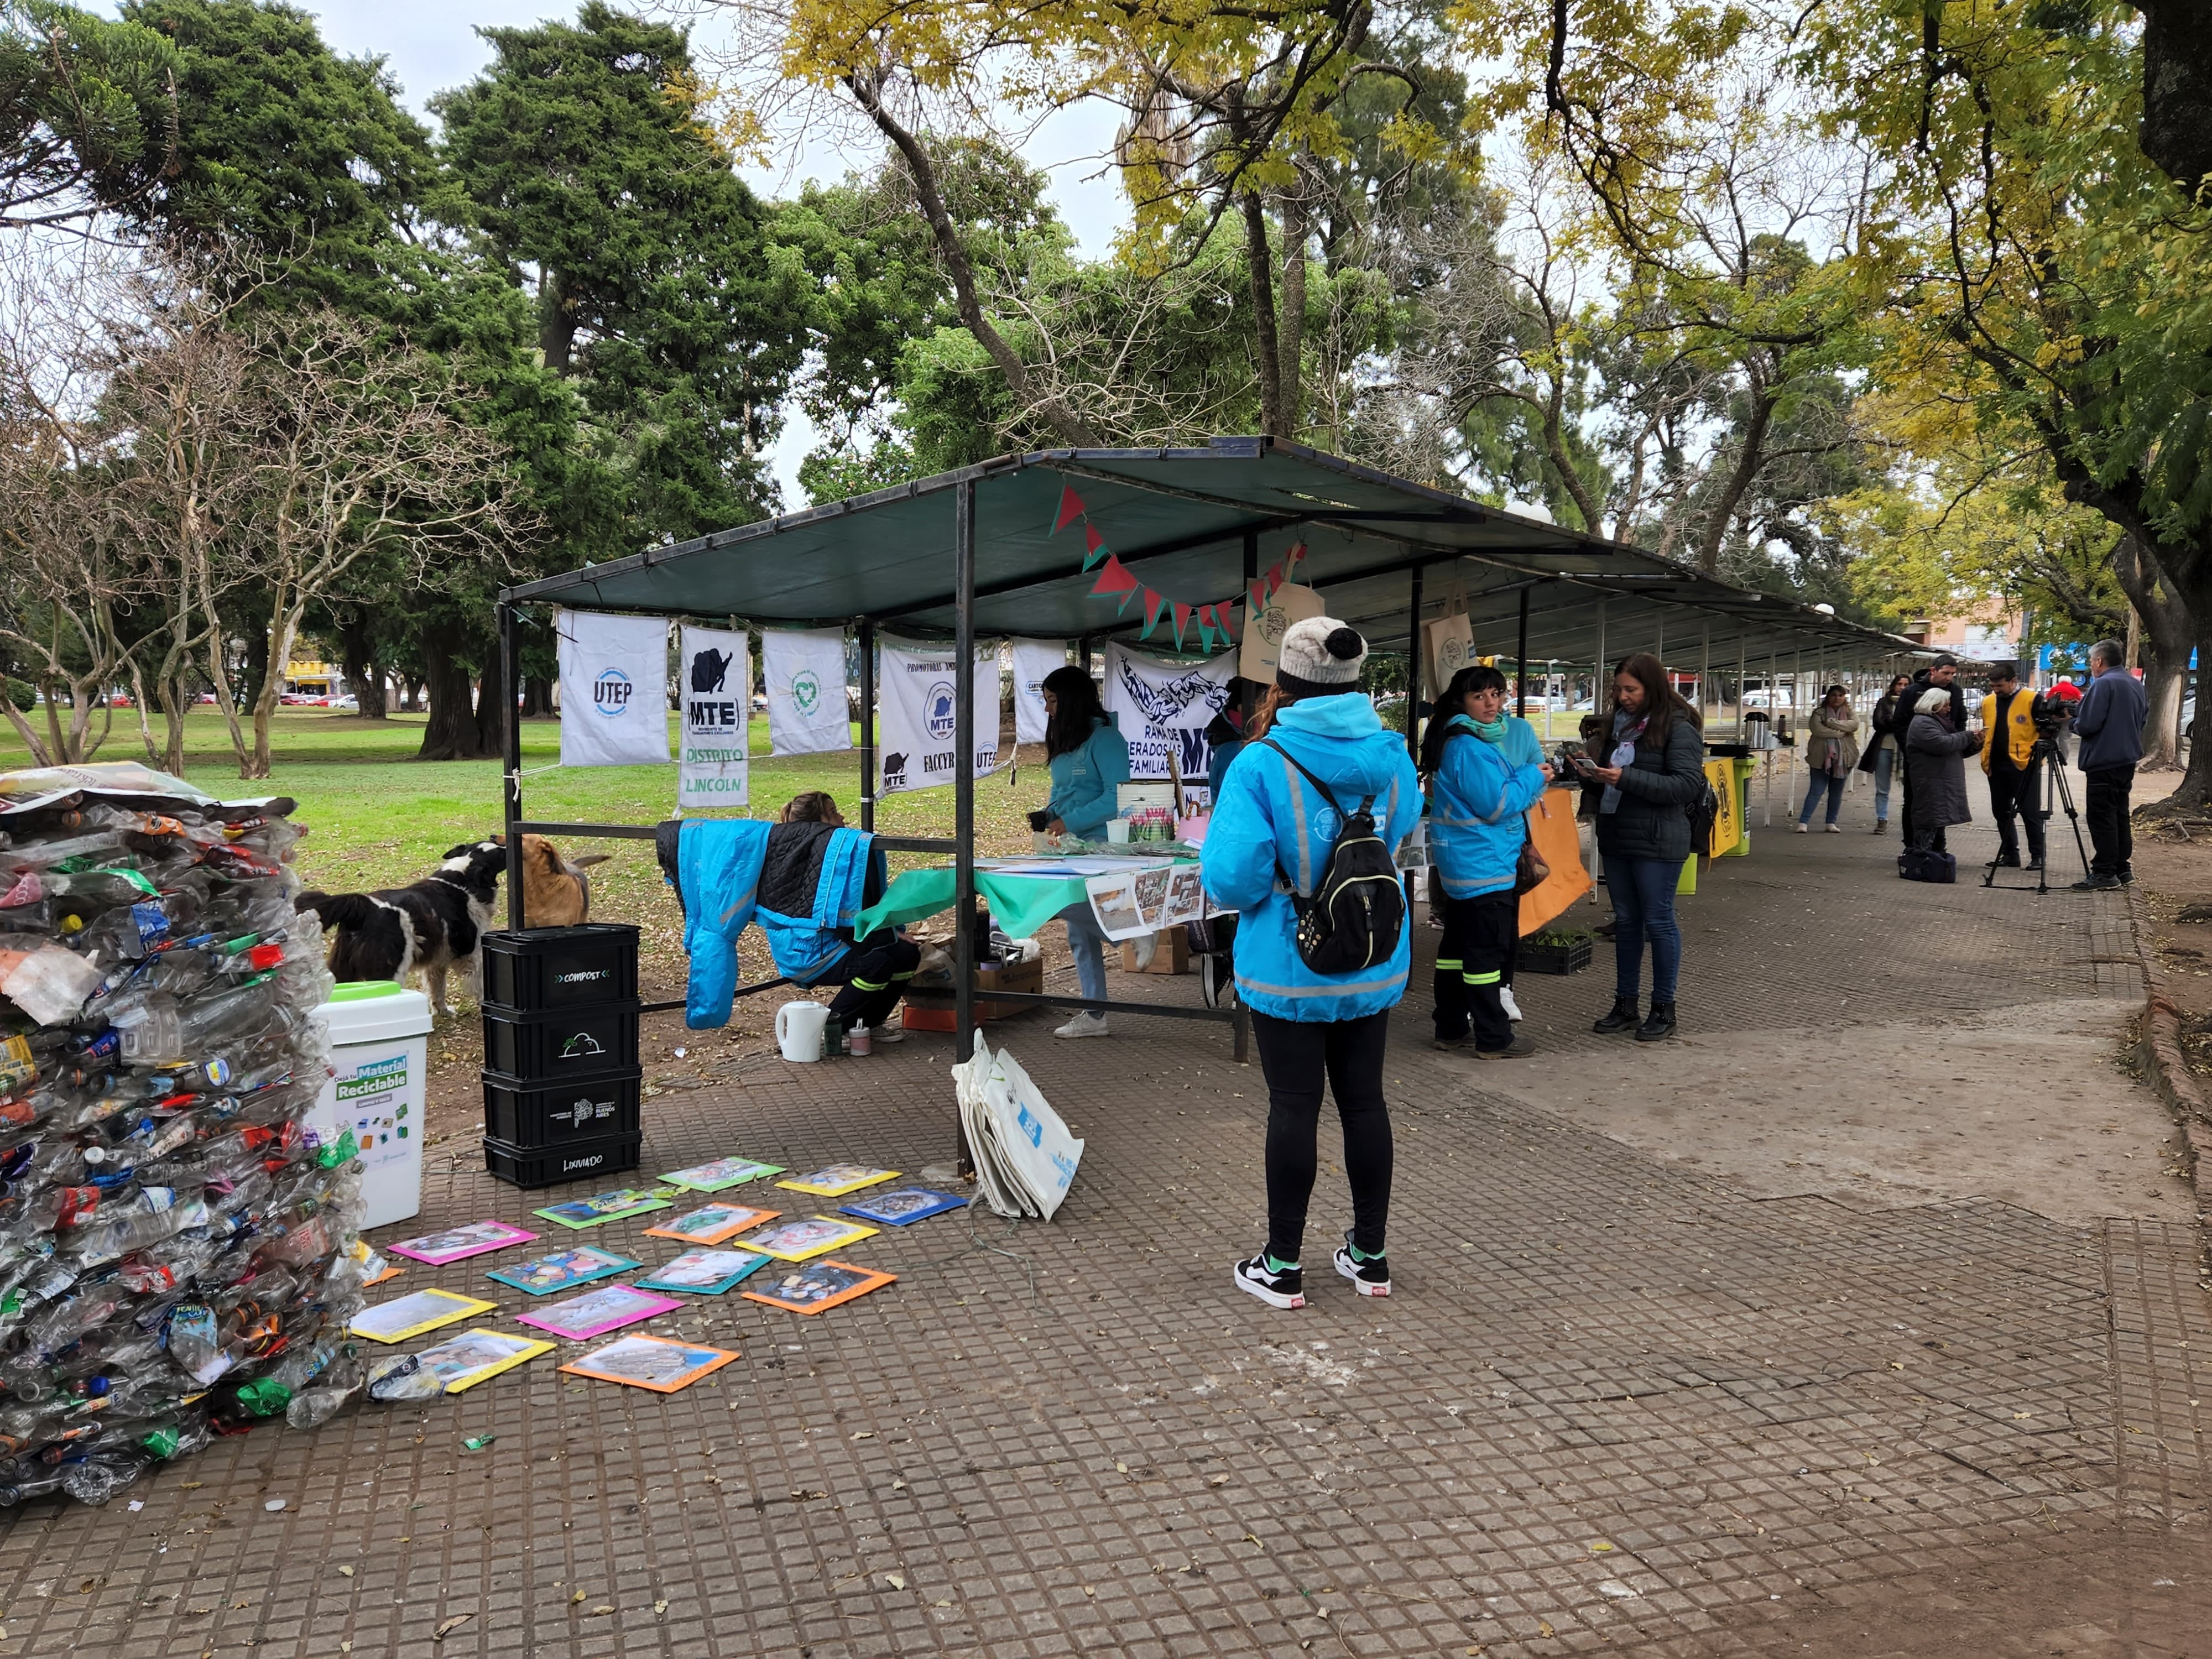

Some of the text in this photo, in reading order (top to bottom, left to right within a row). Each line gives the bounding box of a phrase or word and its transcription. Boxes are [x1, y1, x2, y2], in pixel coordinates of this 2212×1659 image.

[594, 681, 633, 703] UTEP
[931, 718, 954, 731] MTE
[1145, 726, 1180, 742] RAMA DE
[686, 748, 743, 763] DISTRITO
[924, 752, 954, 773] FACCYR
[685, 779, 741, 792] LINCOLN
[885, 775, 906, 787] MTE
[564, 971, 601, 983] COMPOST
[358, 1057, 406, 1079] Material
[338, 1074, 405, 1098] Reciclable
[563, 1155, 603, 1172] LIXIVIADO
